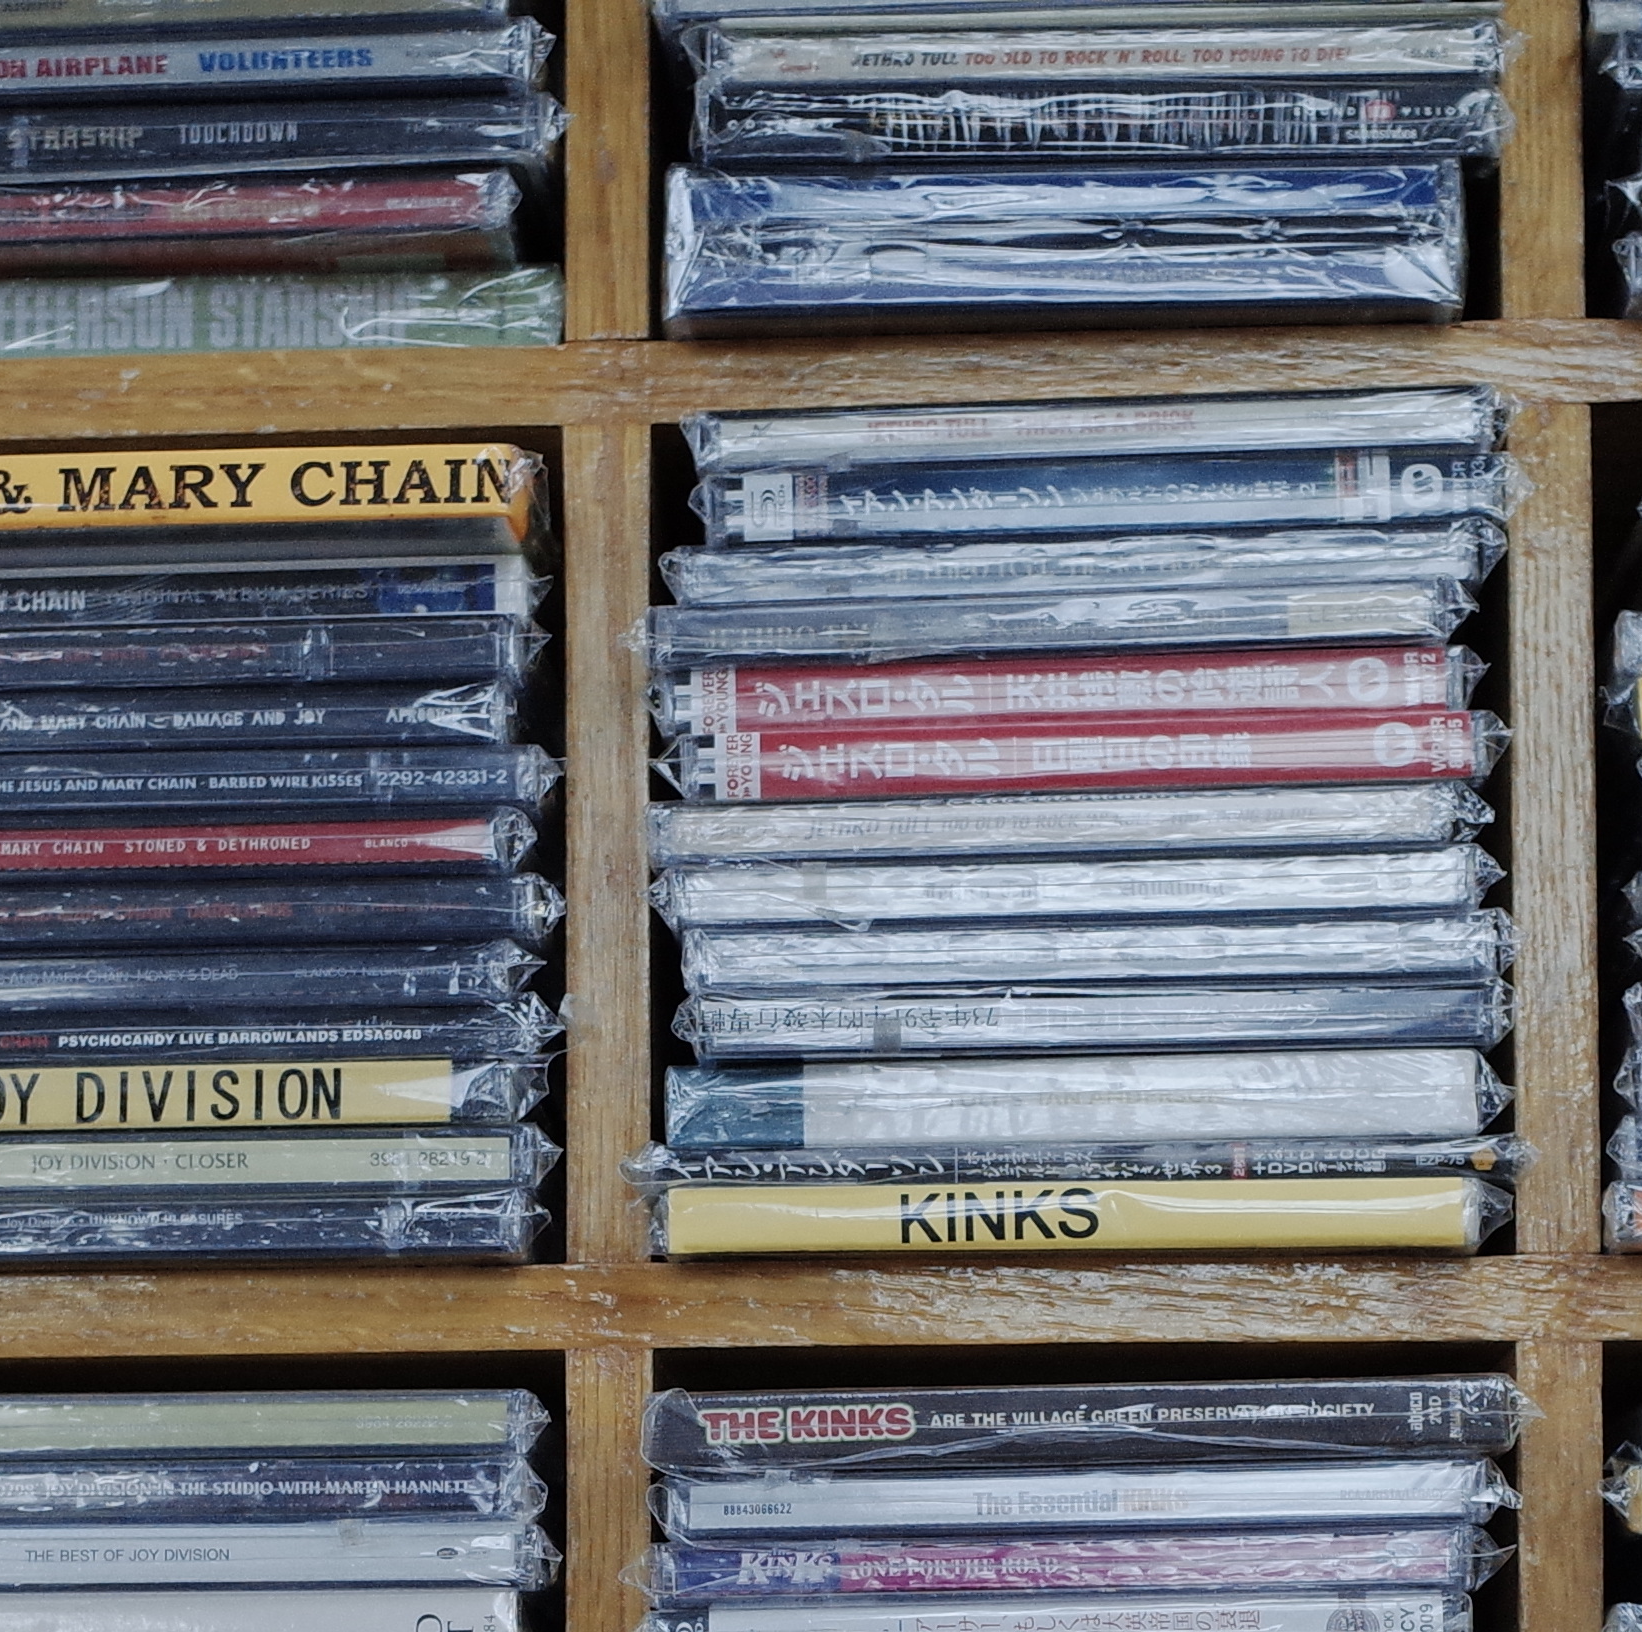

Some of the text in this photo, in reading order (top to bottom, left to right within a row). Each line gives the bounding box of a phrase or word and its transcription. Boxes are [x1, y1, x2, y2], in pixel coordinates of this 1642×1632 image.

[37, 53, 169, 78] AIRPLANE
[198, 47, 373, 72] VOLUNTEERS
[58, 463, 266, 512] MARY
[291, 458, 513, 506] CHAIN
[18, 778, 63, 793] JESUS
[67, 778, 96, 792] AND
[99, 777, 141, 791] MARY
[147, 777, 196, 791] CHAIN
[210, 775, 266, 790] BARBED
[269, 775, 307, 789] WIRE
[312, 774, 362, 789] KISSES
[377, 769, 508, 787] 2292-42331-2
[58, 1029, 339, 1049] PSYCHOCANDY LIVE BARROWLANDS
[77, 1067, 343, 1125] DIVISION
[32, 1152, 250, 1175] JOY DIVISION CLOSER
[899, 1188, 1100, 1245] KINKS
[701, 1405, 1152, 1444] THE KINKS ARE THE VILLAGE GREEN
[25, 1547, 230, 1563] THE BEST OF JOY DIVISION
